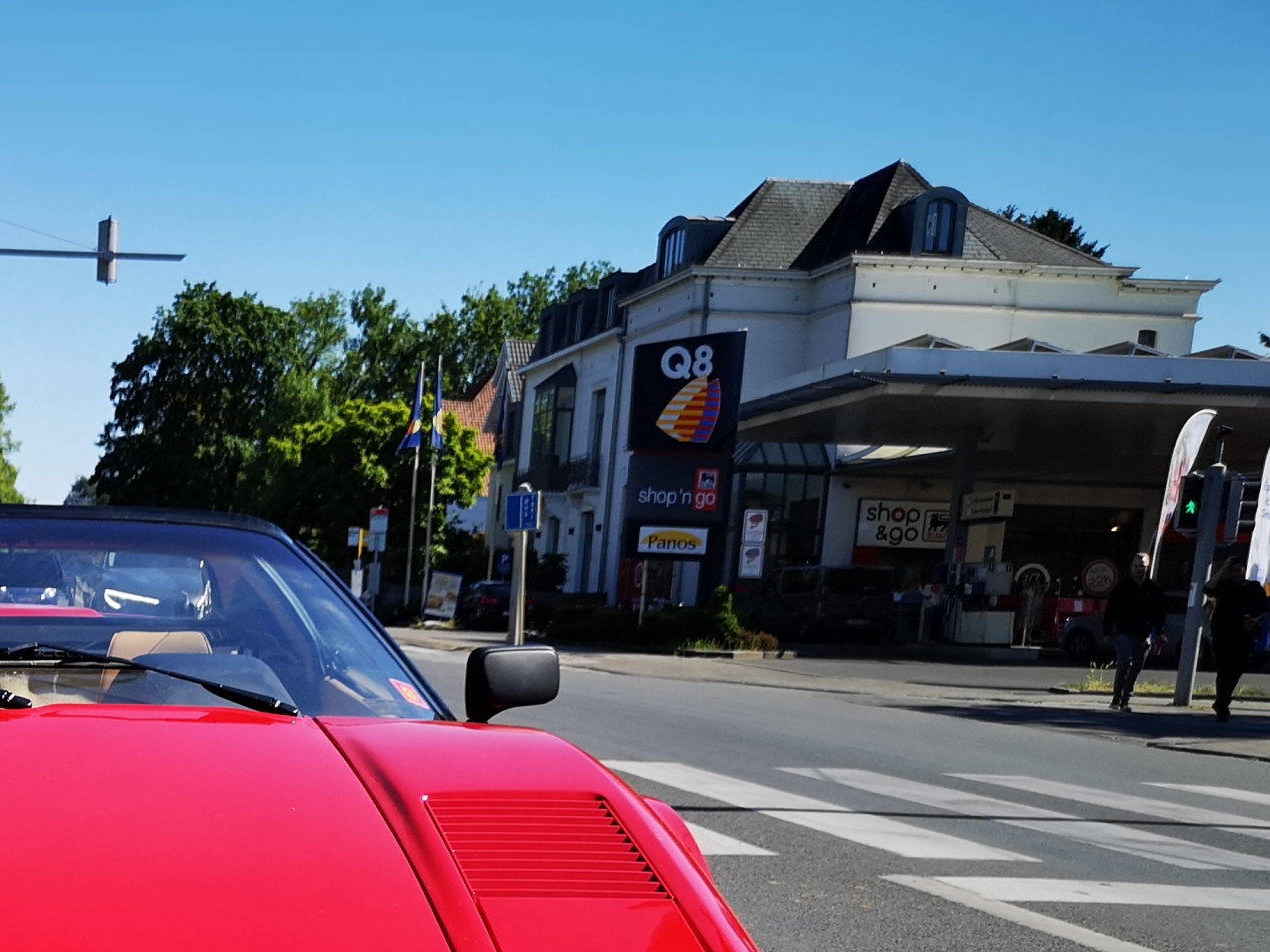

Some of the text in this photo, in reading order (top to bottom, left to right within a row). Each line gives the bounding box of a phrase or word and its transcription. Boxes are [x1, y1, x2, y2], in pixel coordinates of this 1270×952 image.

[661, 345, 713, 379] Q8
[695, 492, 716, 509] go
[866, 502, 921, 526] shop
[647, 535, 697, 551] Panos
[875, 525, 919, 546] &go
[501, 554, 509, 564] P
